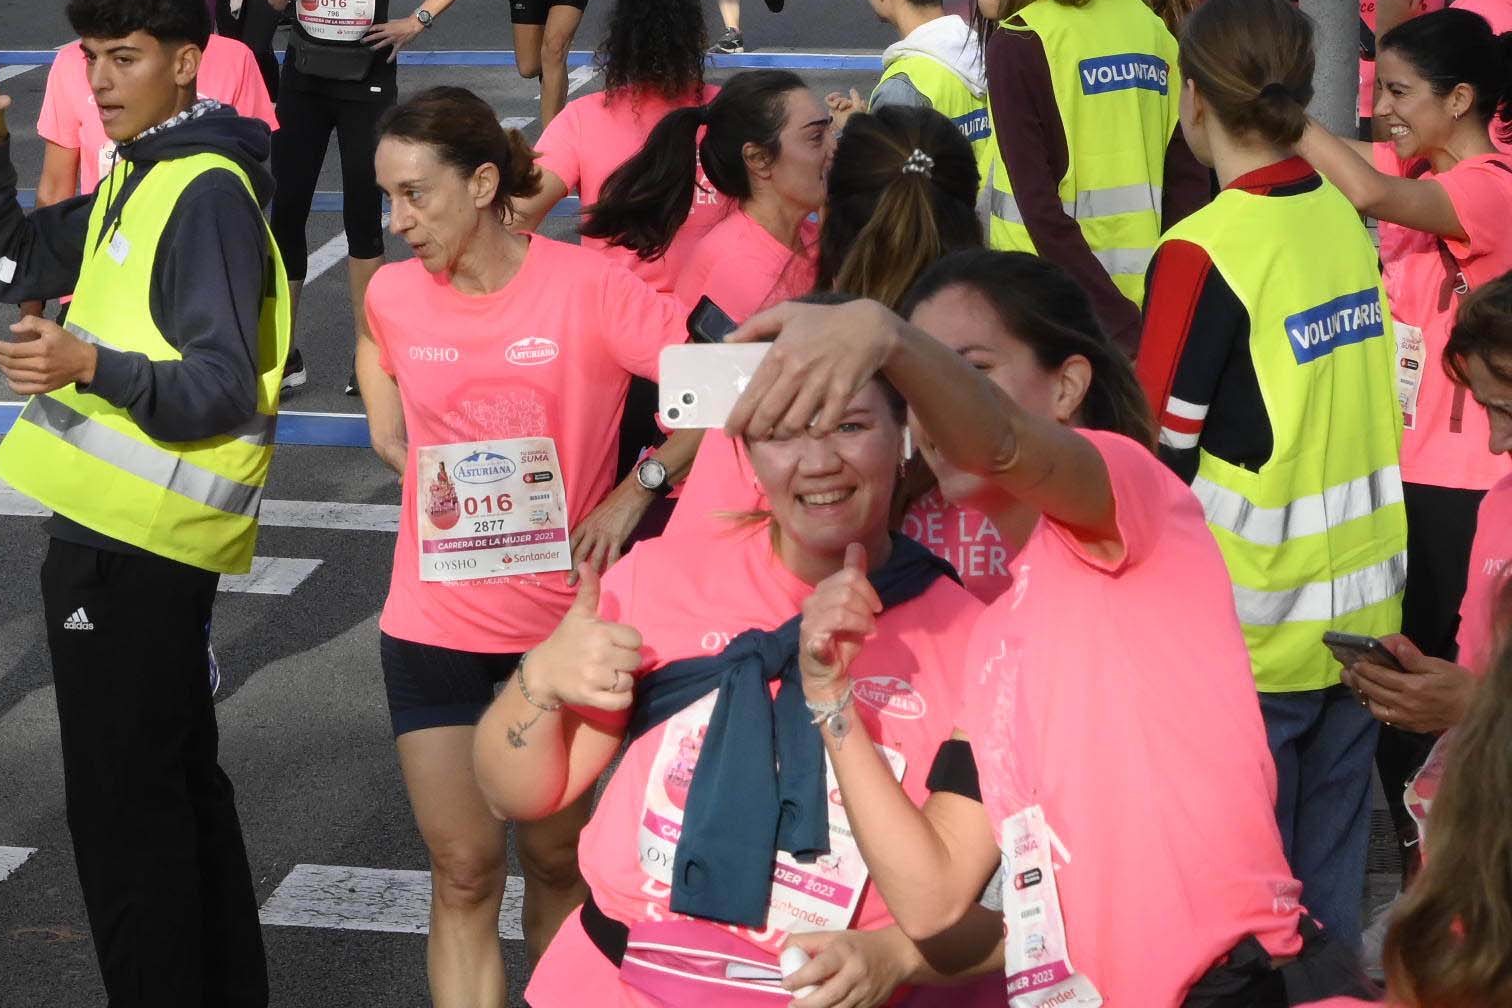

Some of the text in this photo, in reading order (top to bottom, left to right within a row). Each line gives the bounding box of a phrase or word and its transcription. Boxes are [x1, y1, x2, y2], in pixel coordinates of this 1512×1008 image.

[408, 346, 459, 362] OYSHO
[508, 345, 556, 362] ASTURIANA
[521, 454, 549, 464] SUMA
[458, 465, 511, 478] ASTURIANA
[464, 493, 513, 515] 016
[474, 519, 505, 533] 2877
[958, 511, 1002, 543] LA
[438, 532, 554, 551] CARRERA DE LA MUJER 2023
[434, 551, 560, 571] OYSHO Santander
[63, 620, 94, 631] adidas
[805, 873, 836, 898] 2023
[769, 897, 830, 927] antander
[1031, 968, 1055, 987] 2023
